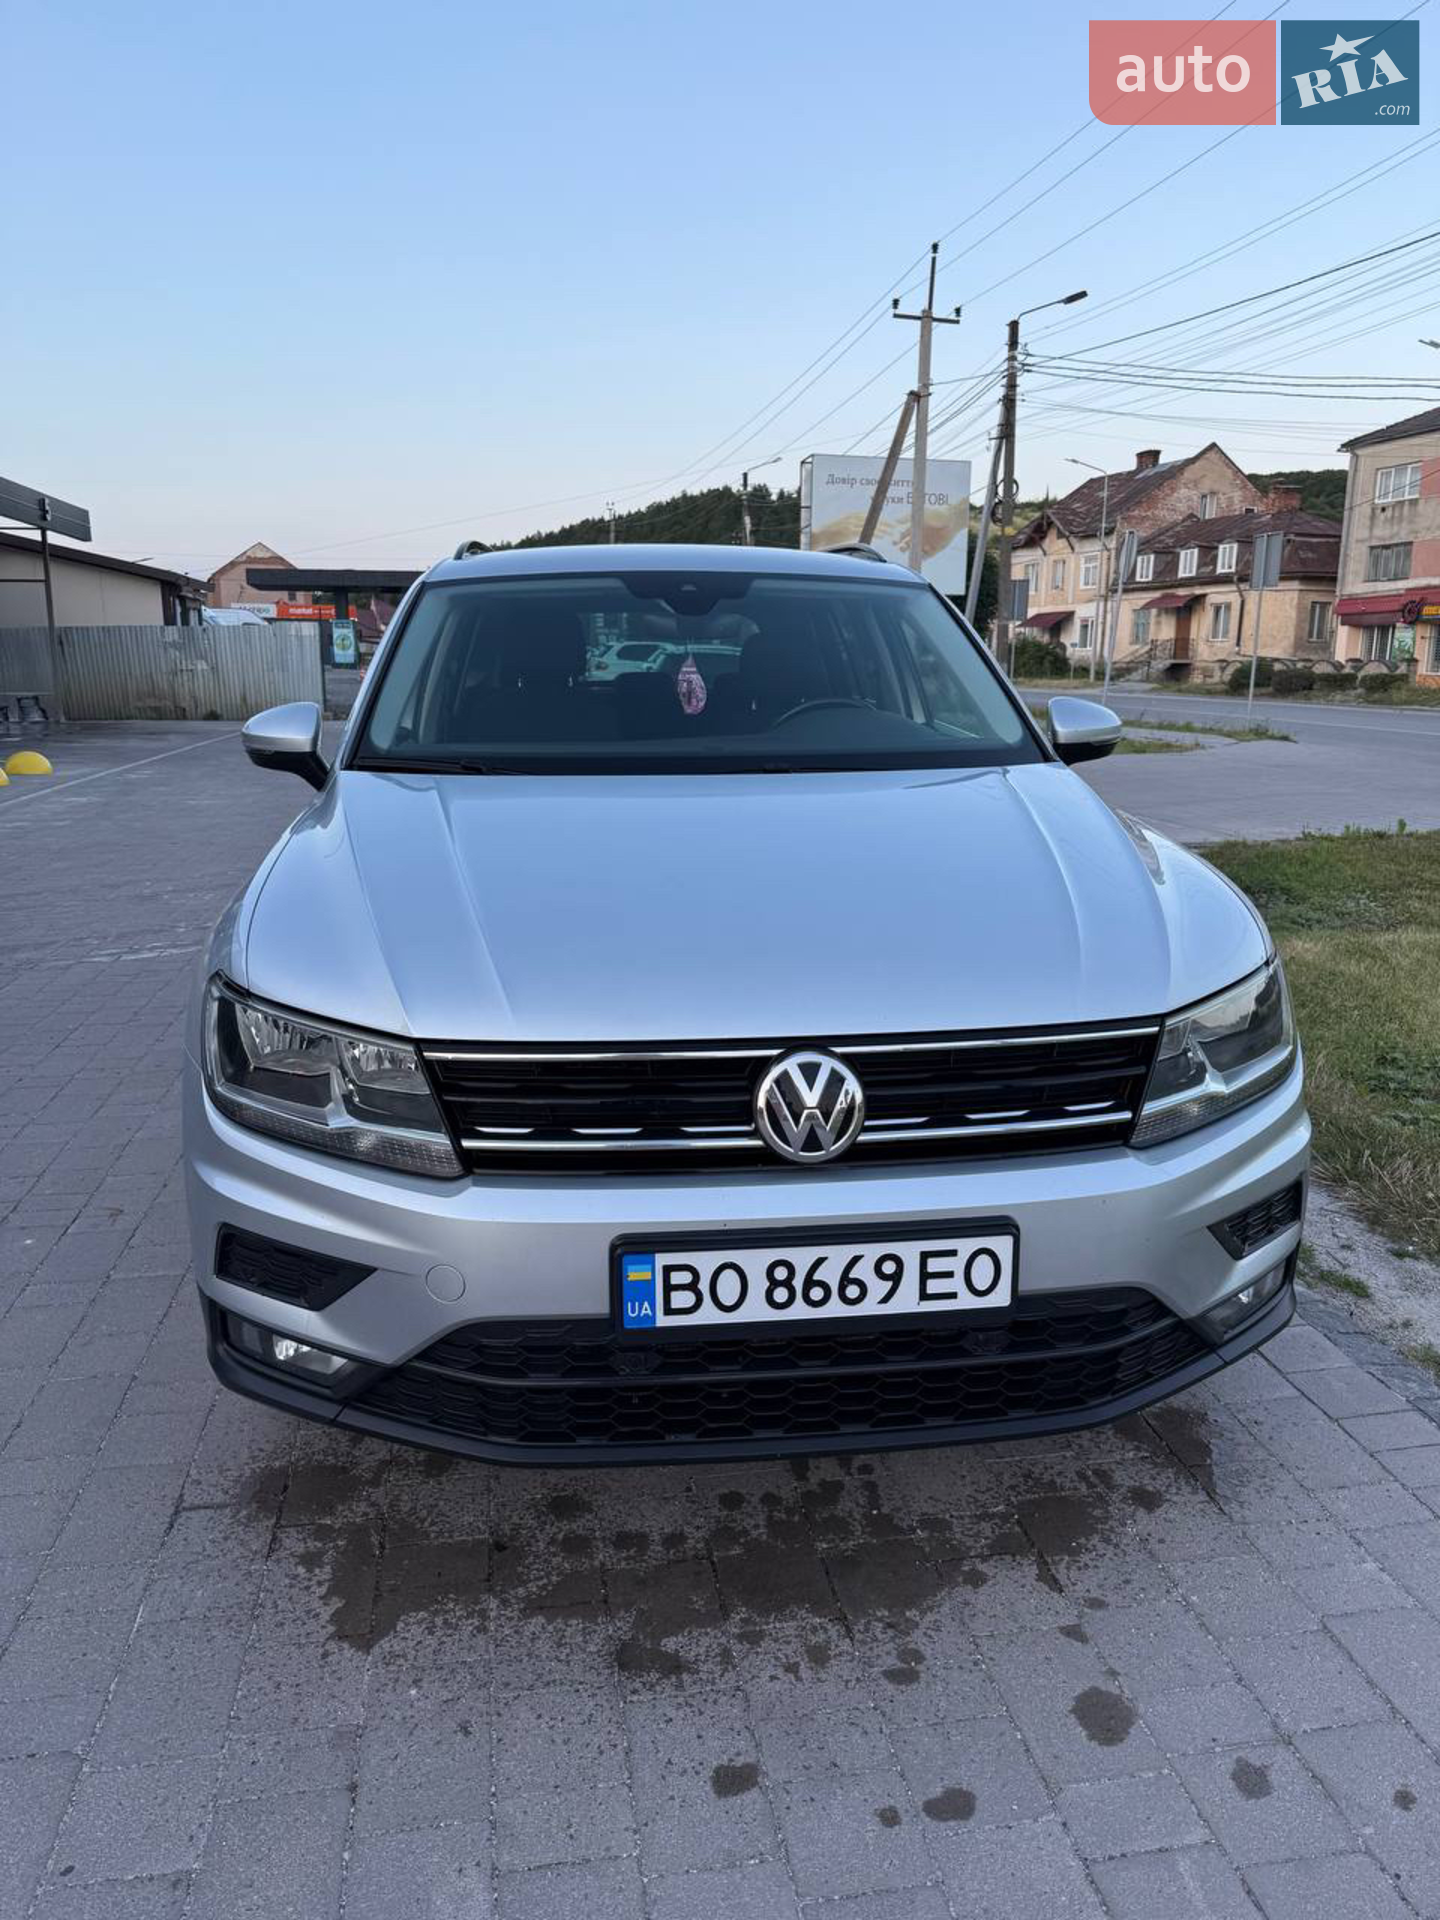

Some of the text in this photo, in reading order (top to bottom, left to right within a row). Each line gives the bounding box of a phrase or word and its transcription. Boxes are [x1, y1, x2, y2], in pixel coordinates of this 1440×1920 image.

[825, 473, 858, 488] Довір
[859, 477, 880, 487] сво
[764, 1253, 905, 1310] 8669
[627, 1301, 652, 1317] UA
